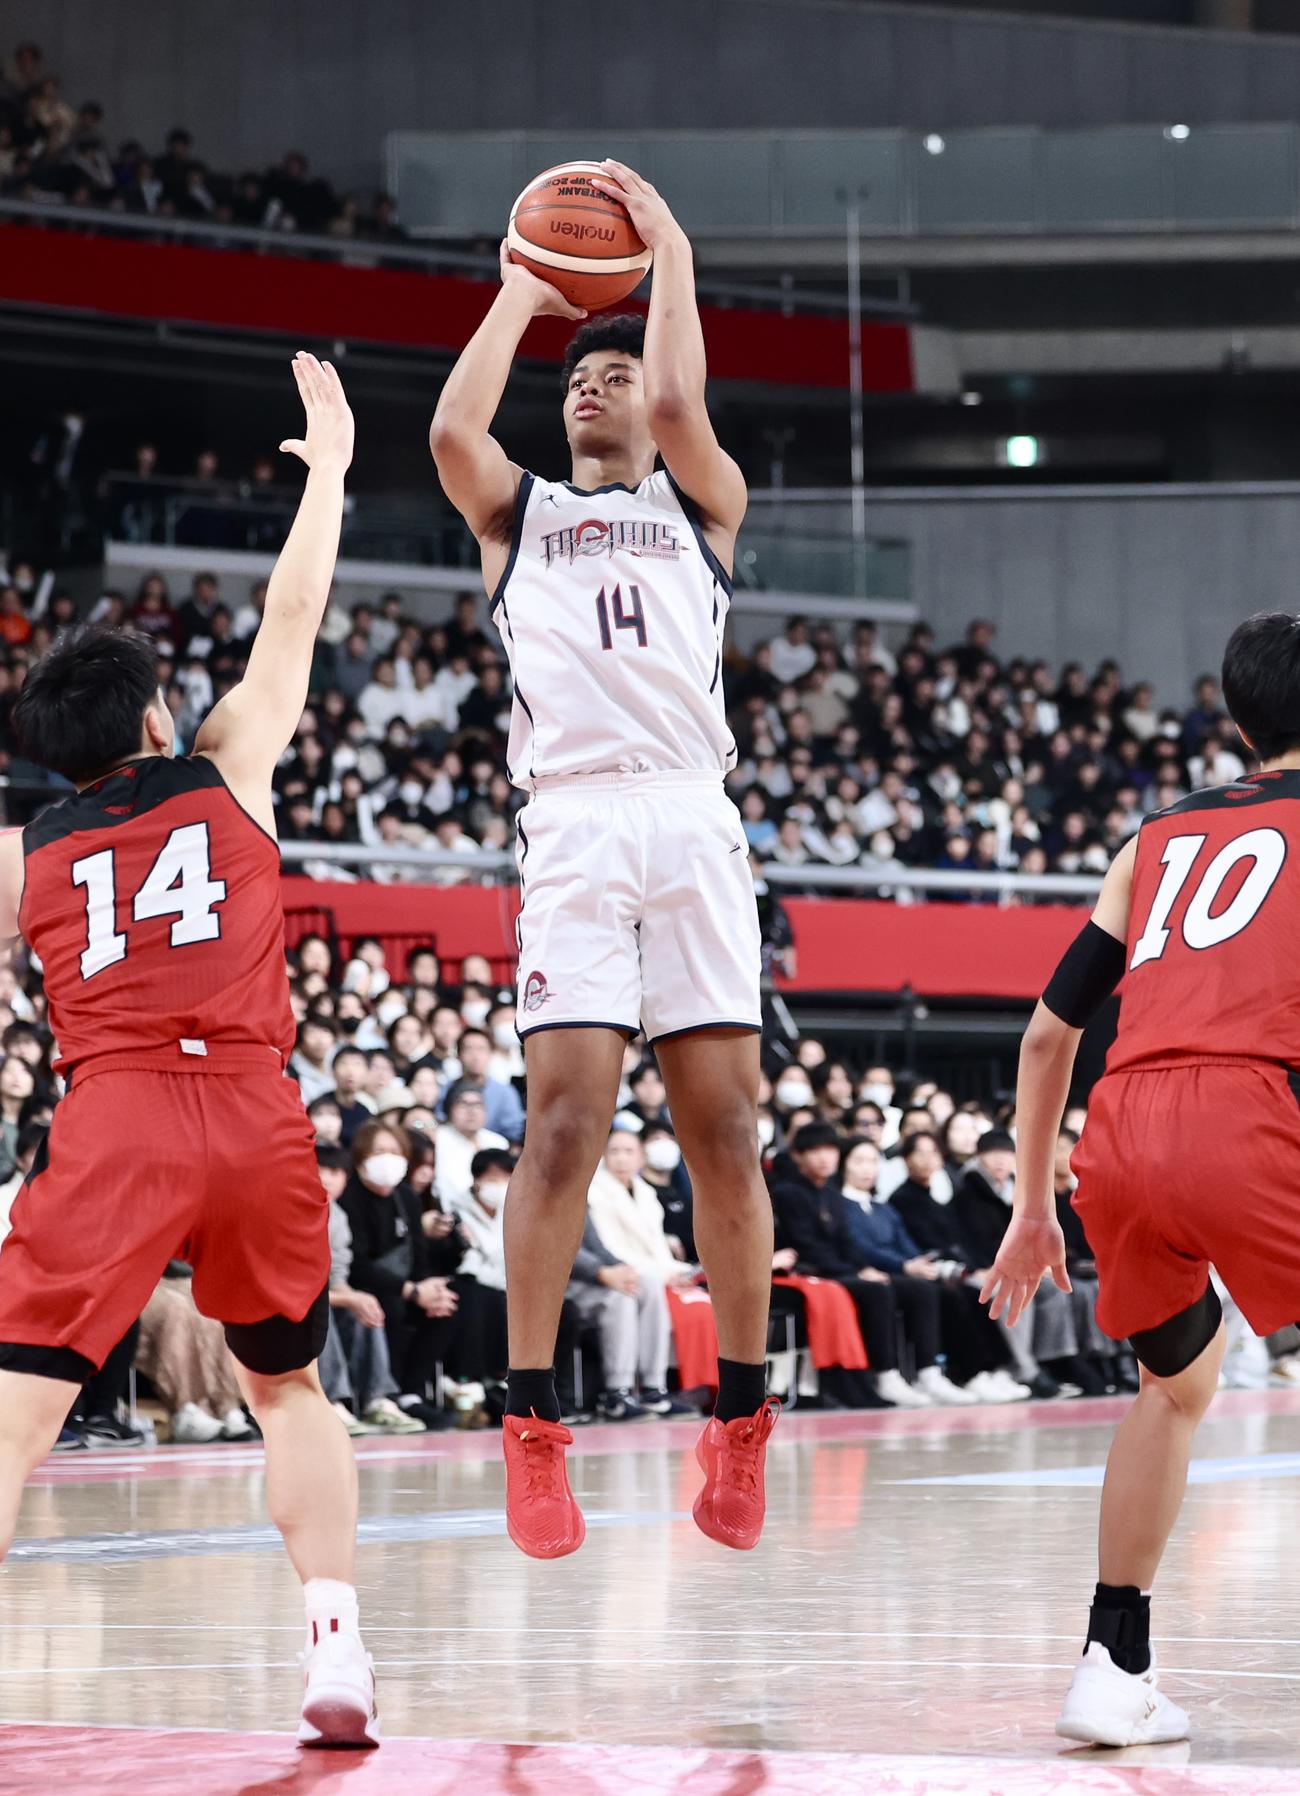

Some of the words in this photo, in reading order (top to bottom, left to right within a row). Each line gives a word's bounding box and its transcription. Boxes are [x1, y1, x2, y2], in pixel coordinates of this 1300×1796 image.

[550, 219, 616, 242] molten
[595, 582, 648, 650] 14
[71, 818, 227, 983] 14
[1129, 826, 1288, 972] 10
